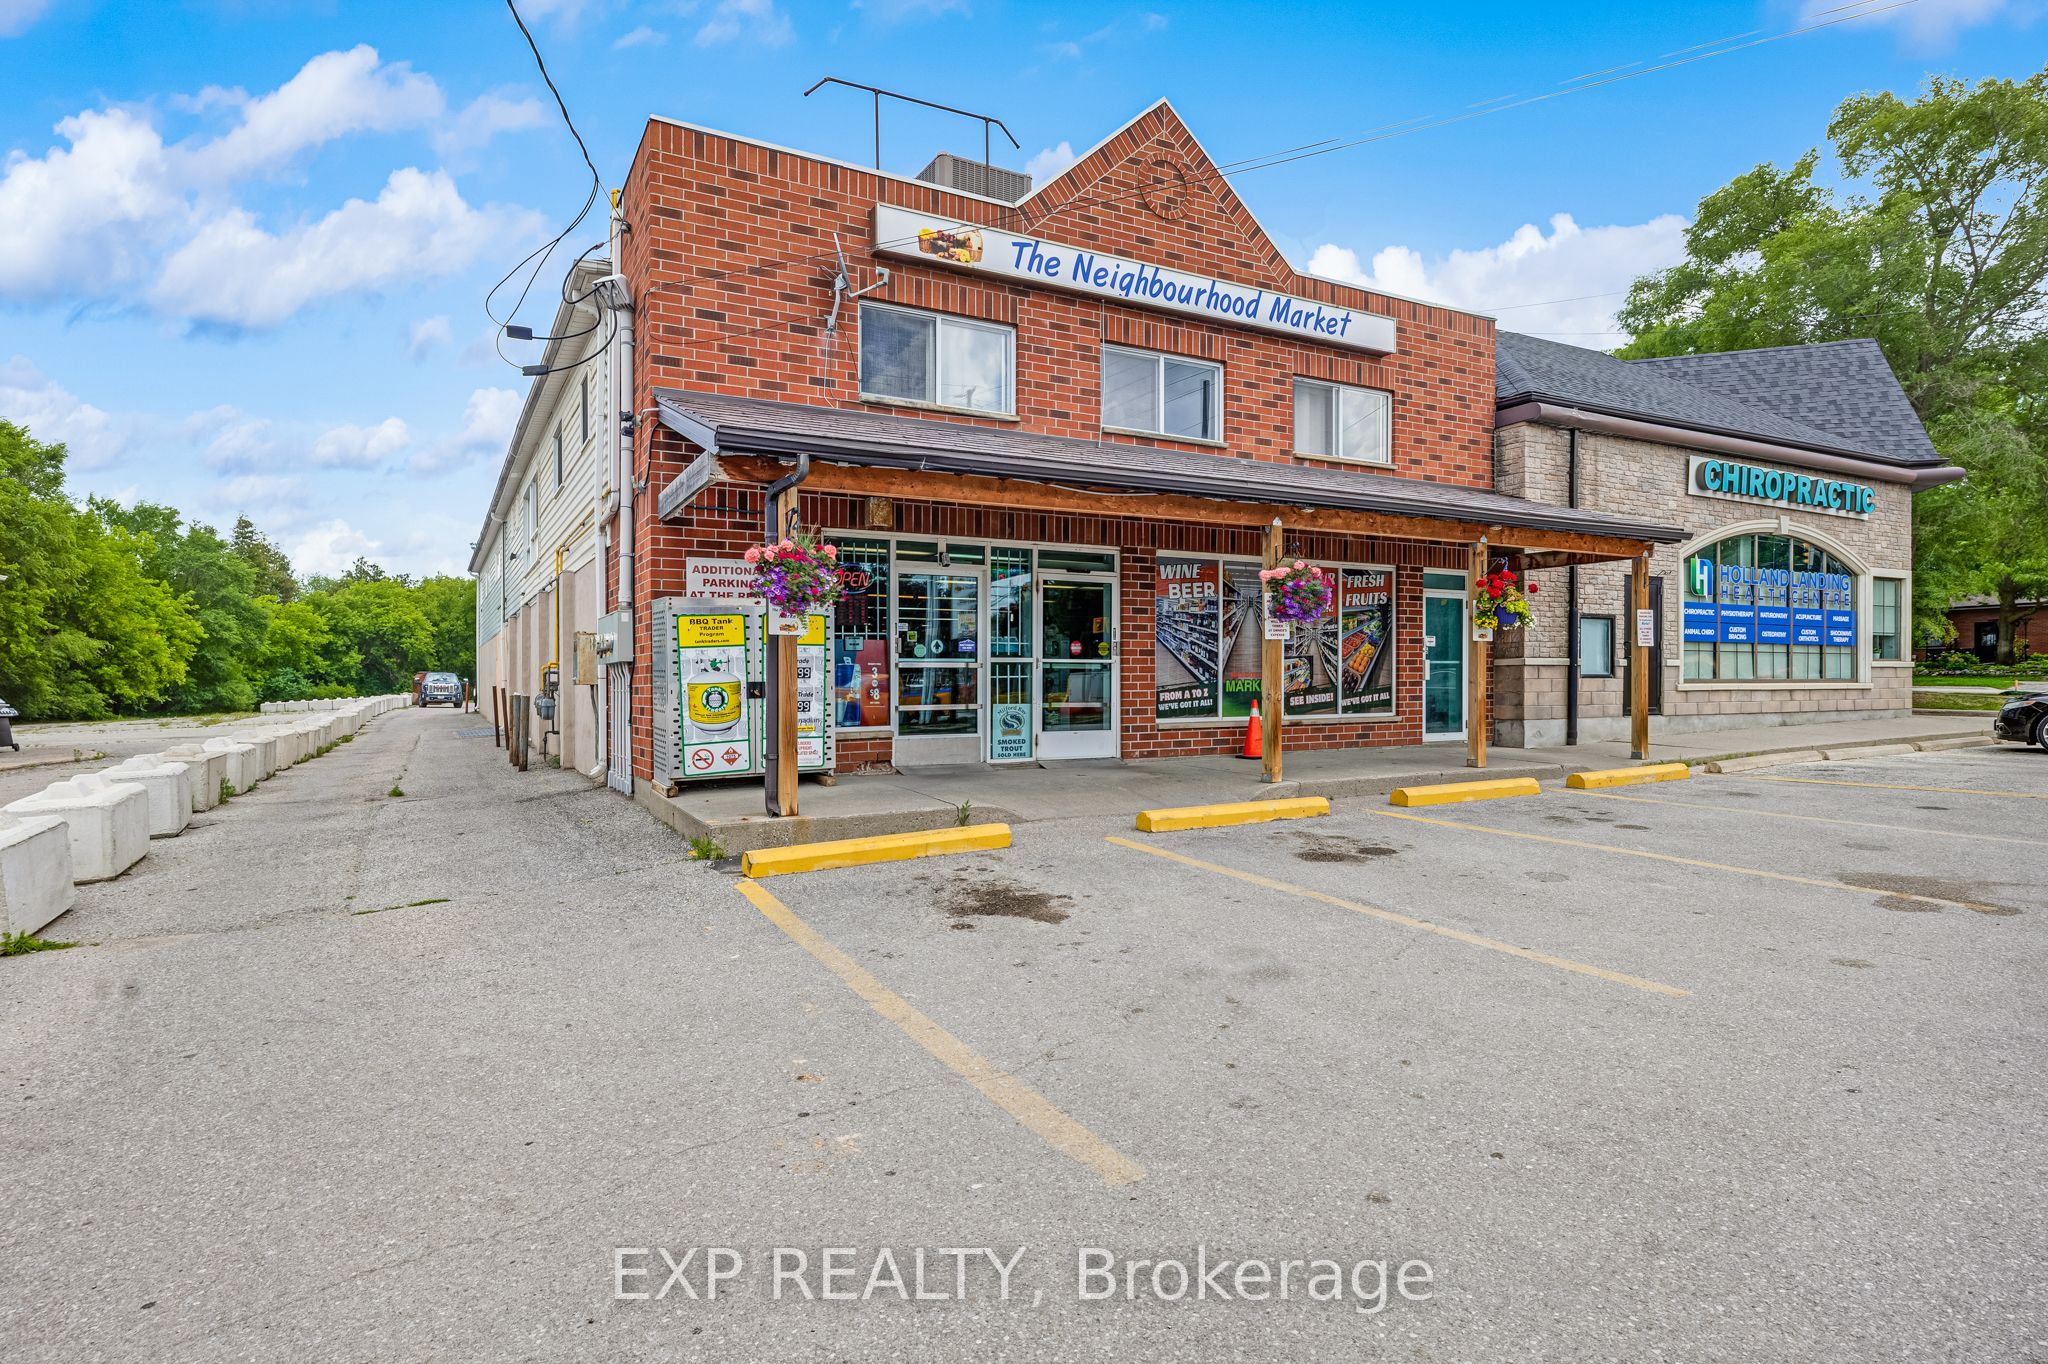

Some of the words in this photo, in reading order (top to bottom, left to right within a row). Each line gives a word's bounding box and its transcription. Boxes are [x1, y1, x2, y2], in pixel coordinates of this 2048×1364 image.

[1011, 240, 1061, 277] The
[1072, 253, 1262, 319] Neighbourhood
[1268, 297, 1352, 337] Market
[1703, 459, 1875, 513] CHIROPRACTIC
[692, 565, 760, 576] ADDITIONA
[1160, 564, 1202, 580] WINE
[703, 578, 749, 588] PARKIN
[833, 571, 870, 587] OPEN
[1347, 574, 1385, 589] FRESH
[1720, 564, 1789, 587] HOLLAND
[1791, 570, 1849, 592] LANDING
[1168, 582, 1217, 600] BEER
[1720, 585, 1786, 603] HEALTH
[1792, 590, 1850, 607] CENTRE
[1345, 592, 1388, 607] FRUITS
[1684, 608, 1715, 616] CHIROPRACTIC
[1721, 610, 1754, 618] PHYSIOTHERAPY
[1795, 613, 1823, 621] ACUPUNCTURE
[1761, 630, 1787, 638] OSTEOPATHY
[871, 667, 878, 679] 3
[1226, 679, 1262, 692] MARK
[870, 688, 880, 700] $8
[1160, 690, 1183, 701] FROM
[1184, 690, 1190, 699] A
[1191, 689, 1202, 698] TO
[1202, 688, 1209, 697] Z
[1289, 695, 1305, 706] SEE
[1306, 692, 1334, 704] INSIDE!
[1341, 697, 1360, 706] WE'VE
[1360, 695, 1372, 703] GOT
[1379, 692, 1390, 700] ALL
[1158, 701, 1179, 711] WE'VE
[1180, 700, 1192, 709] GOT
[1193, 699, 1199, 707] IT
[1200, 698, 1213, 707] ALL!
